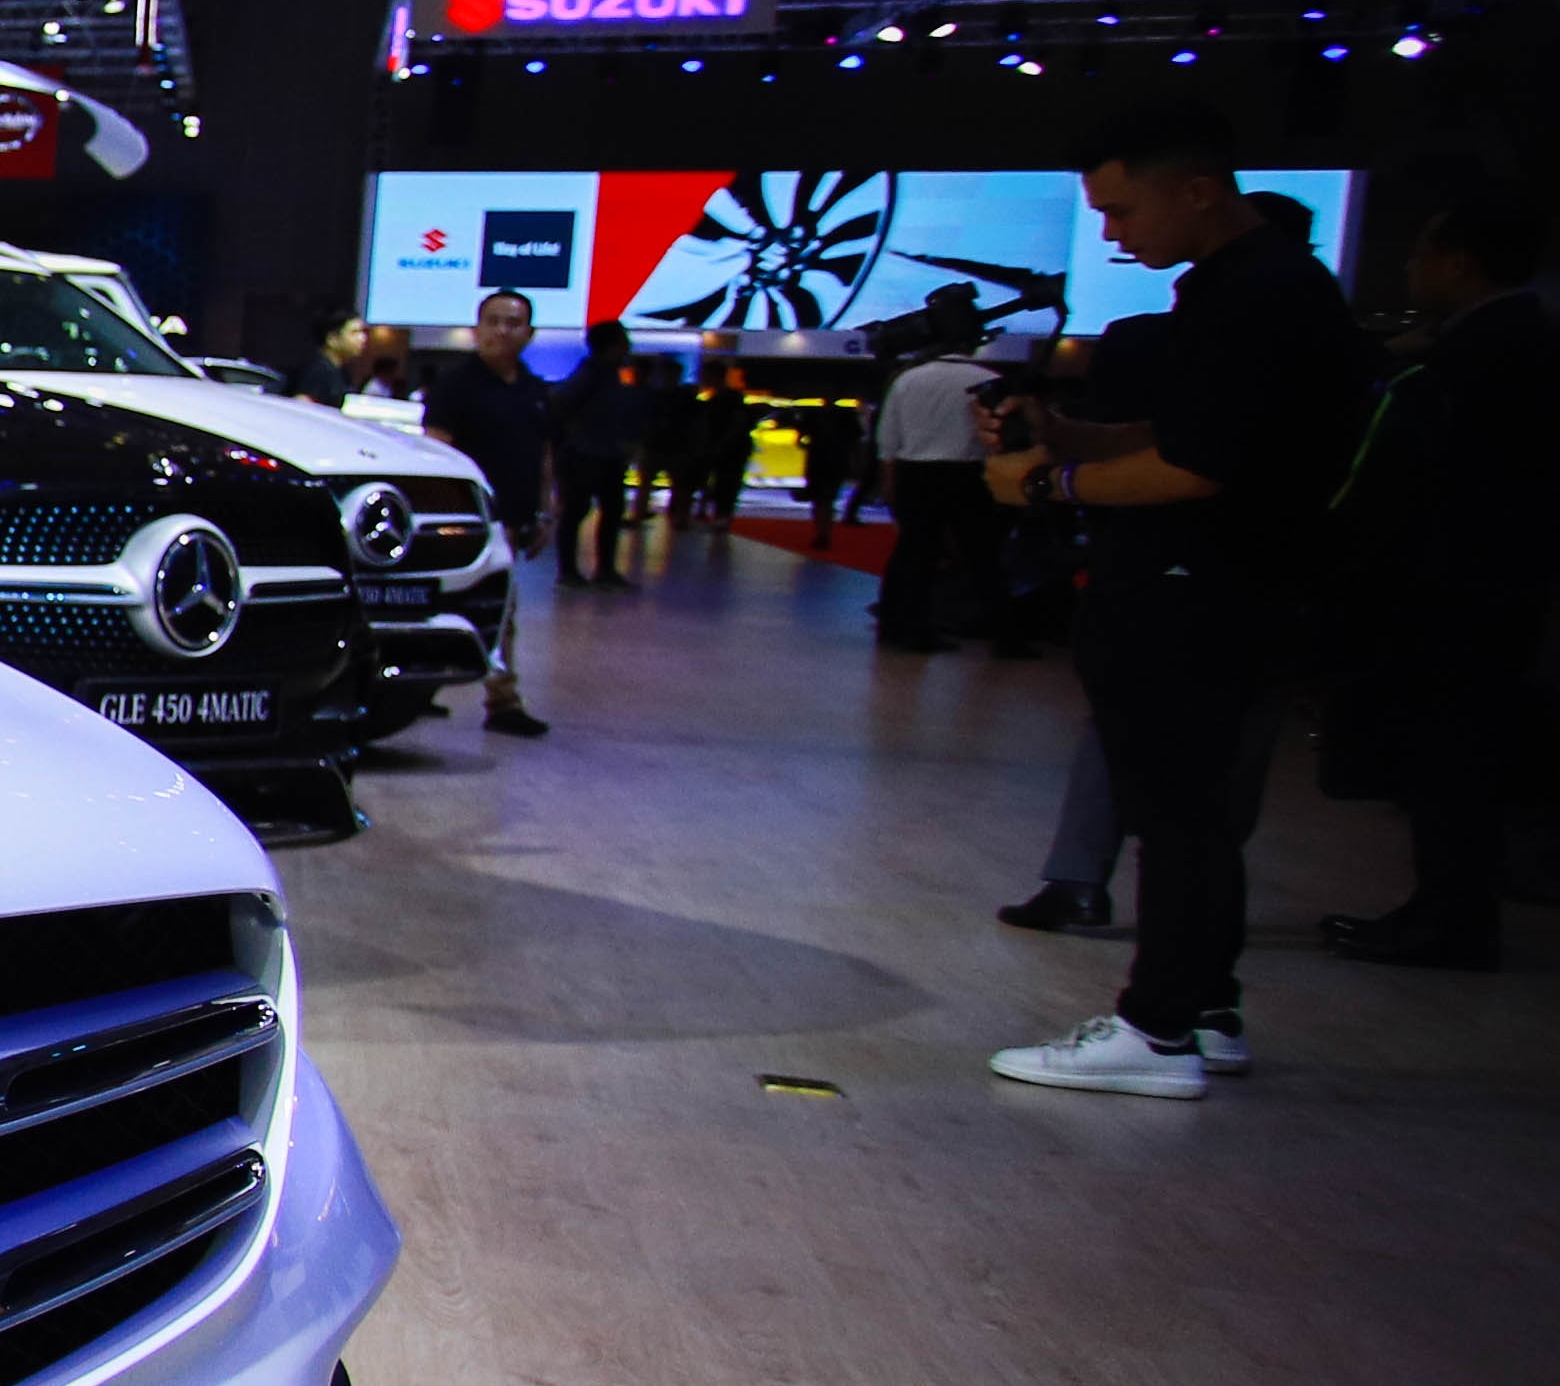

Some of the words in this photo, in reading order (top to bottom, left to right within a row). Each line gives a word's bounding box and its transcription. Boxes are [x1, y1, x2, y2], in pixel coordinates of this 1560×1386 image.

[99, 693, 145, 725] GLE
[151, 692, 193, 724] 450
[197, 690, 270, 723] 4MATIC
